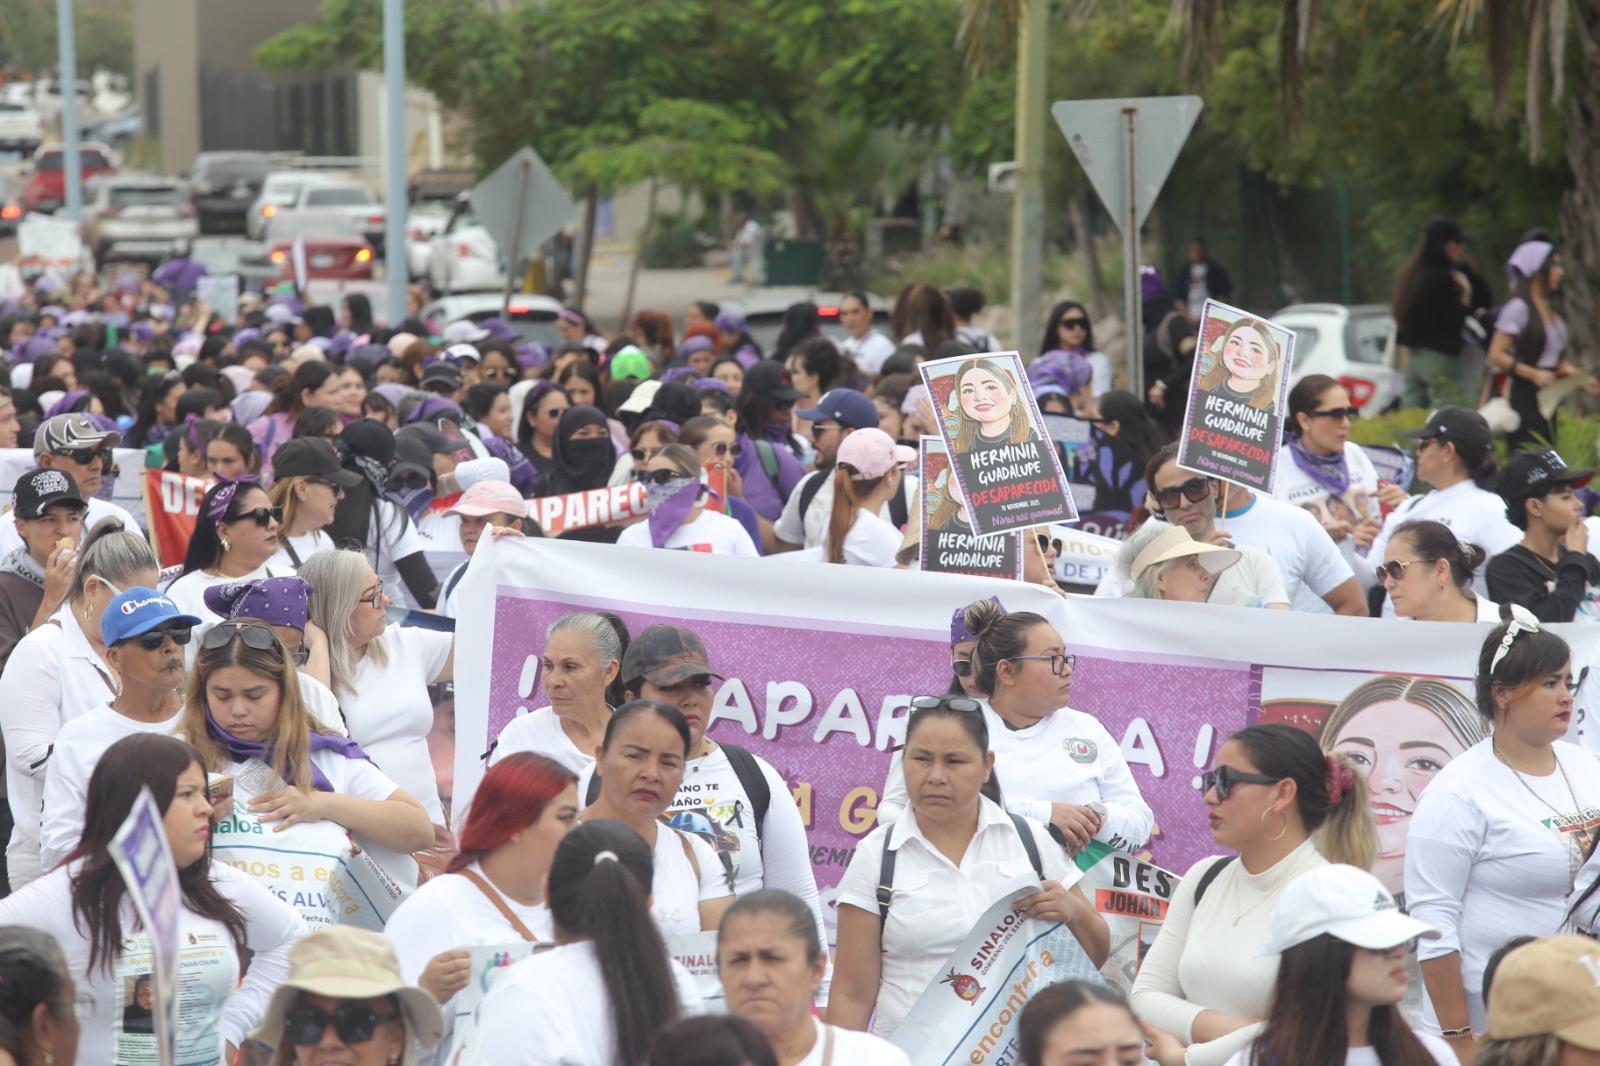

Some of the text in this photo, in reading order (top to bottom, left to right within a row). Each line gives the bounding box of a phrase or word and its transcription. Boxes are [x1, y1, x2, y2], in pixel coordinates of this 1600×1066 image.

[1205, 395, 1268, 429] HERMINIA
[1205, 413, 1265, 442] GUADALUPE
[970, 442, 1039, 470] HERMINIA
[1190, 427, 1270, 464] DESAPARECIDA
[978, 461, 1041, 486] GUADALUPE
[161, 472, 213, 516] DE
[972, 477, 1059, 507] DESAPARECIDA
[522, 482, 648, 532] APAREC
[937, 532, 1005, 553] HERMINIA
[939, 552, 1004, 568] GUADALUPE
[1064, 562, 1088, 579] DE
[676, 783, 719, 793] ANO TE
[670, 796, 702, 807] RAÑO
[213, 814, 263, 835] aloa
[290, 865, 304, 881] a
[1113, 857, 1175, 898] DES
[293, 891, 330, 908] ALV
[1011, 917, 1025, 933] ESTA
[971, 909, 1026, 970] SINALOA
[673, 954, 714, 968] INAL
